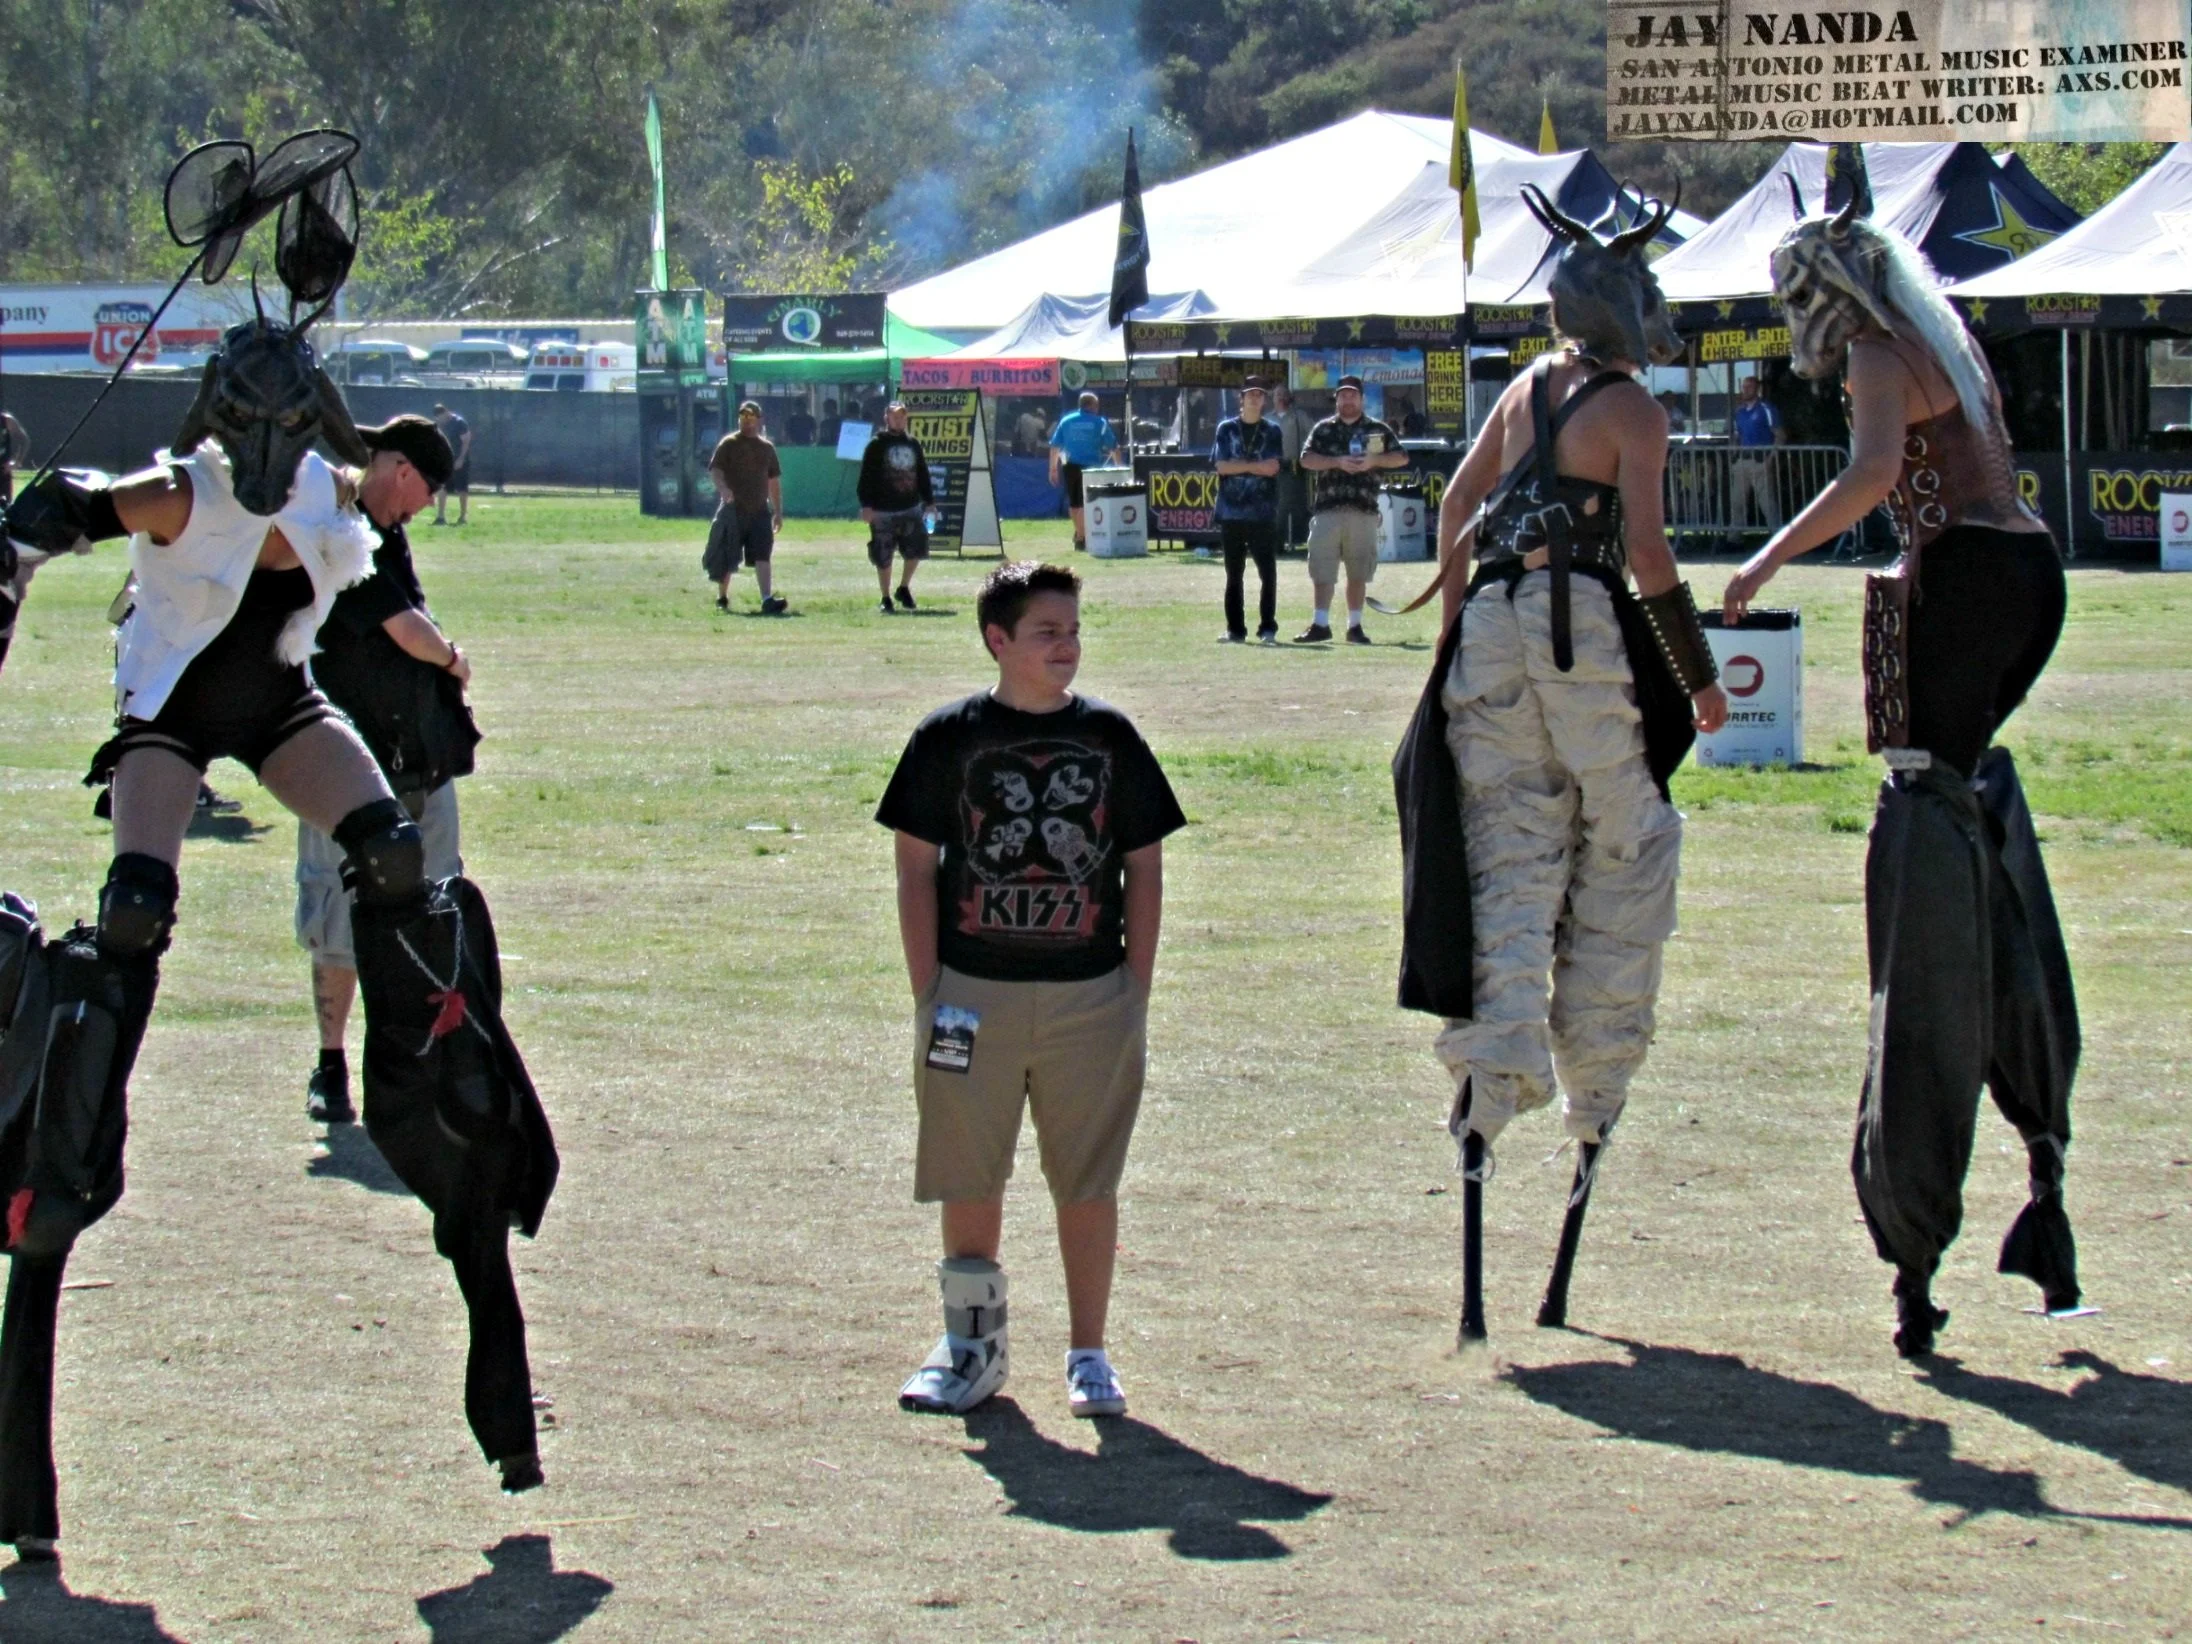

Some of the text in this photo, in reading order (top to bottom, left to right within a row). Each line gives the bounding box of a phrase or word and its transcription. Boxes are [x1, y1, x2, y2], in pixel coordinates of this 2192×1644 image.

[100, 311, 150, 324] UNION
[1520, 338, 1548, 352] EXIT
[1704, 331, 1746, 347] ENTER
[1714, 345, 1745, 359] HERE
[1427, 352, 1461, 369] FREE
[904, 370, 949, 385] TACOS
[971, 368, 1052, 384] BURRITOS
[1427, 371, 1462, 384] DRINKS
[1427, 386, 1462, 402] HERE
[908, 418, 972, 438] RTIST
[1159, 511, 1212, 528] ENERGY
[2107, 516, 2160, 536] ENER
[1727, 712, 1776, 722] RRTEC
[980, 886, 1085, 929] KISS
